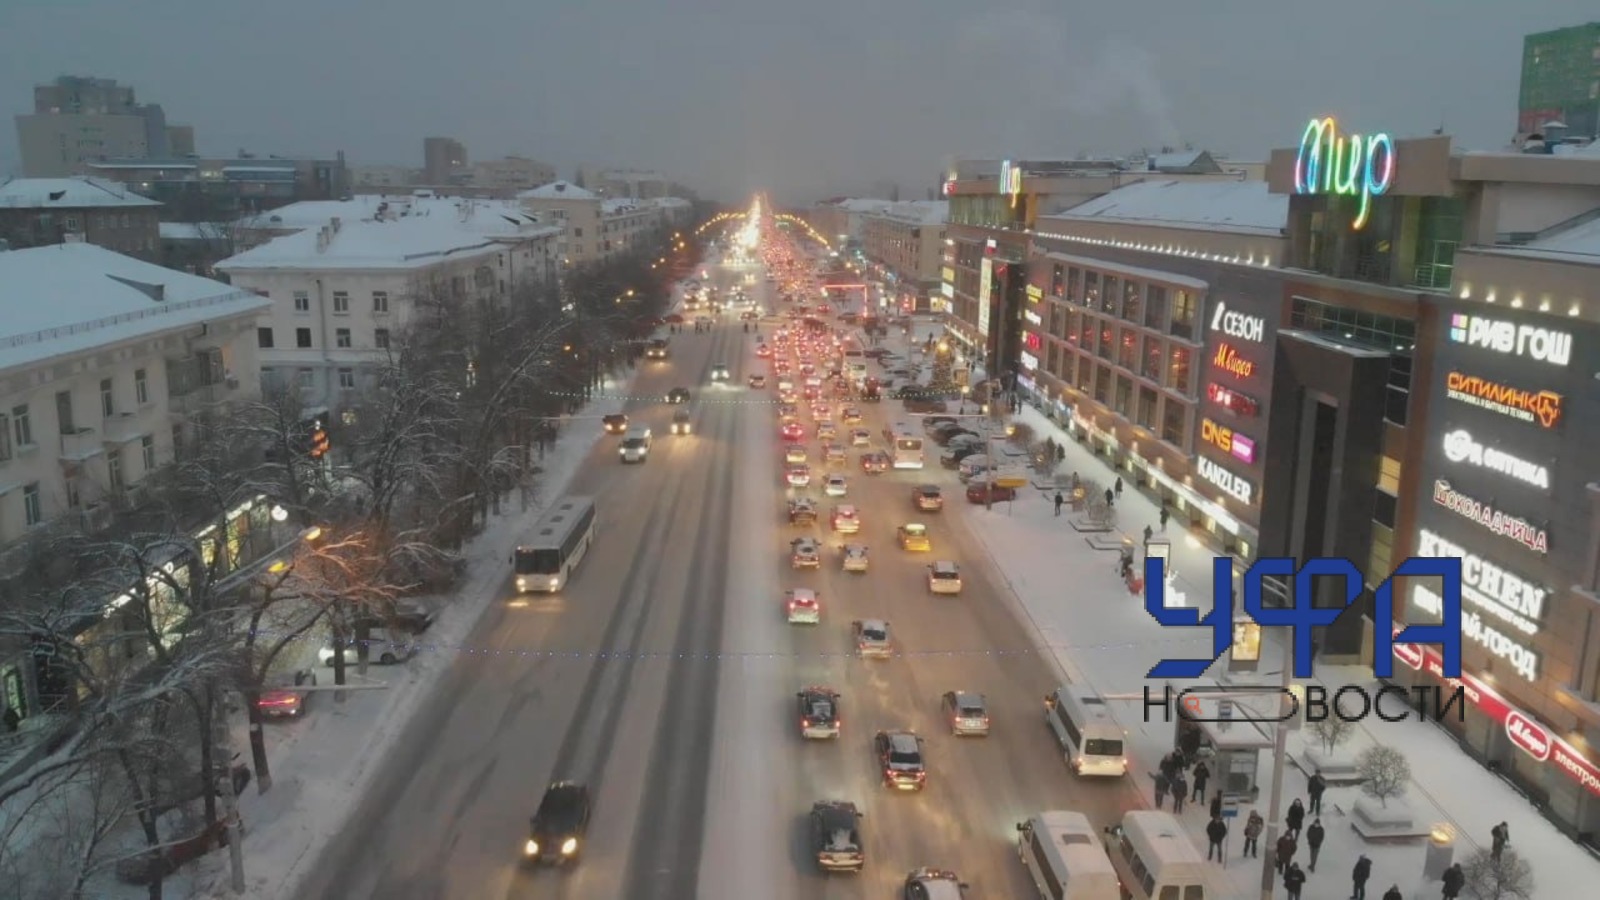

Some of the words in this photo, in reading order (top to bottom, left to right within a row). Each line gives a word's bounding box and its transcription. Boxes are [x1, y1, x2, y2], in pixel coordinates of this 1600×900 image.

[1294, 116, 1393, 231] Мир
[1223, 311, 1264, 343] СЕЗОН
[1468, 316, 1513, 353] РИВ
[1516, 325, 1572, 366] ГОШ
[1448, 372, 1537, 412] СИТИЛИНК
[1201, 418, 1232, 452] DNS
[1196, 455, 1252, 506] KANZLER
[1433, 480, 1548, 553] ШОКОЛАДНИЦА
